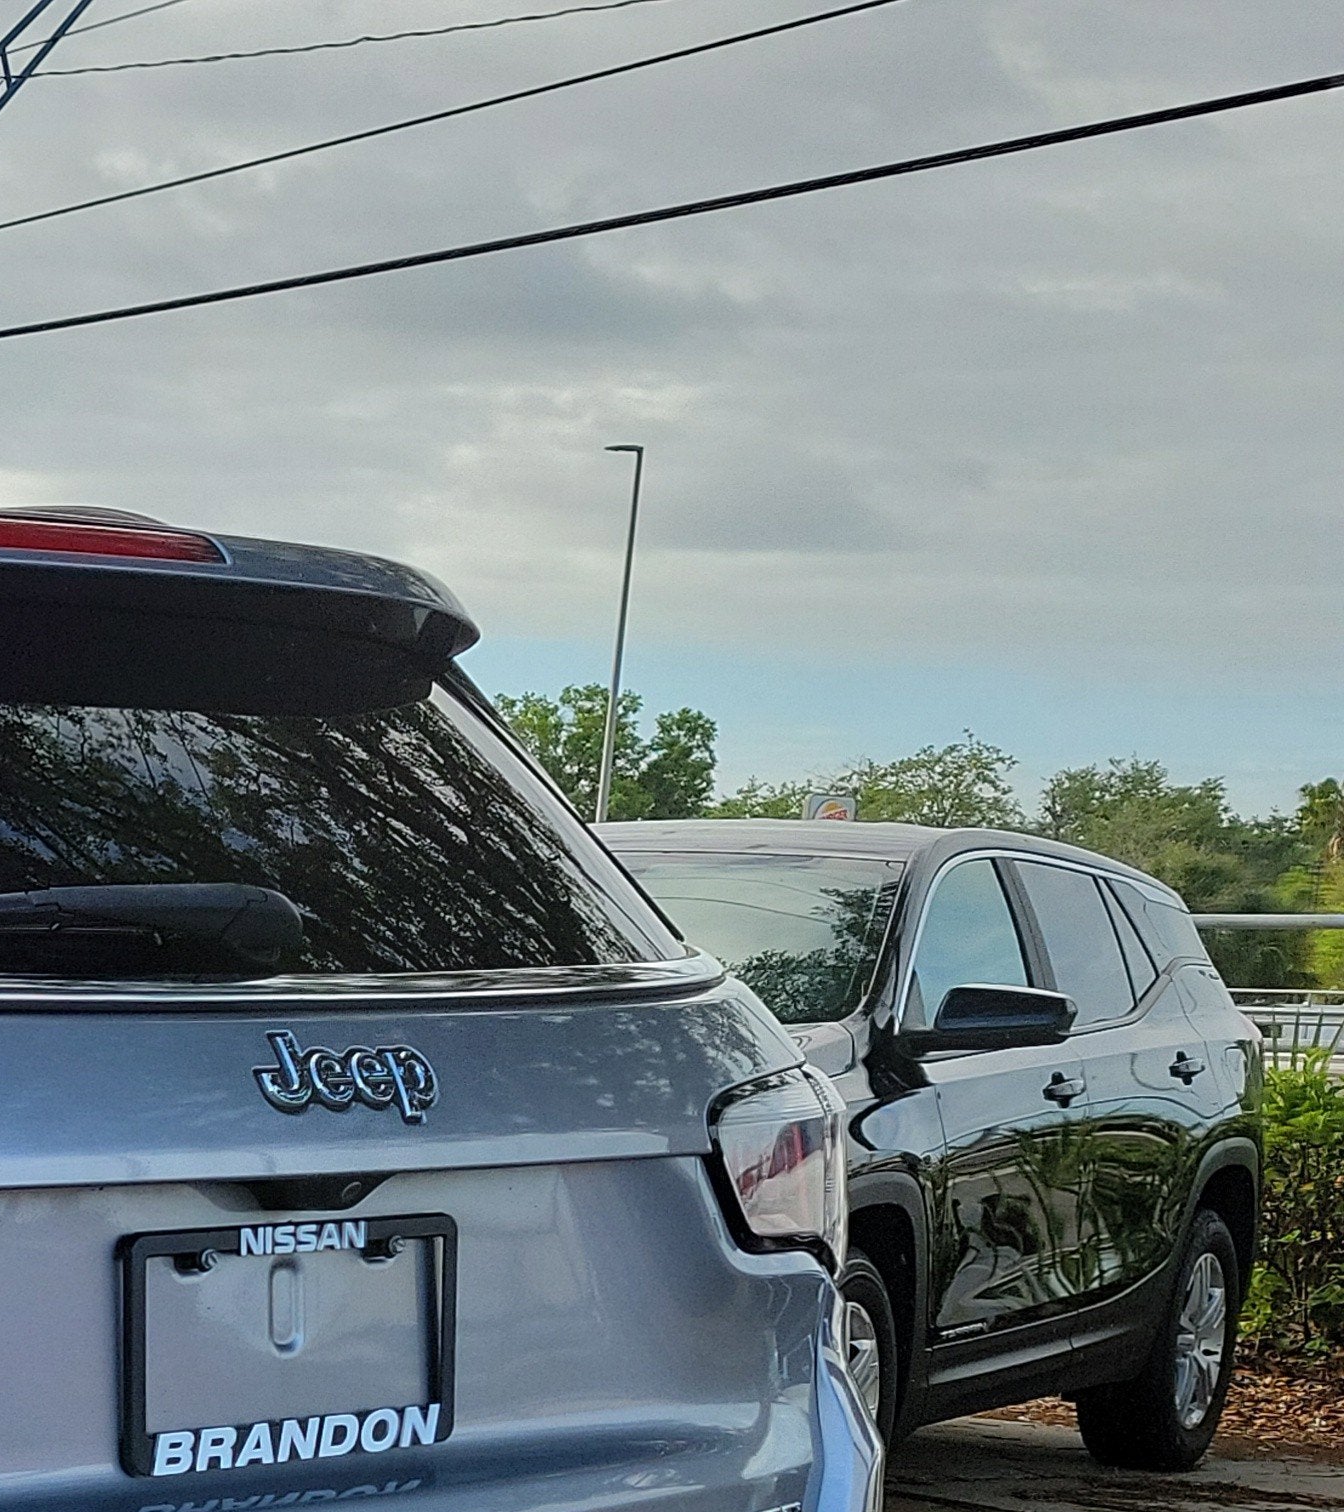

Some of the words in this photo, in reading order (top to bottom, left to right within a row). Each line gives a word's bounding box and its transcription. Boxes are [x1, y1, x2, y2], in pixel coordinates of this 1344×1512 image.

[252, 1029, 439, 1124] Jeep
[240, 1220, 368, 1257] NISSAN
[151, 1403, 441, 1477] BRANDON
